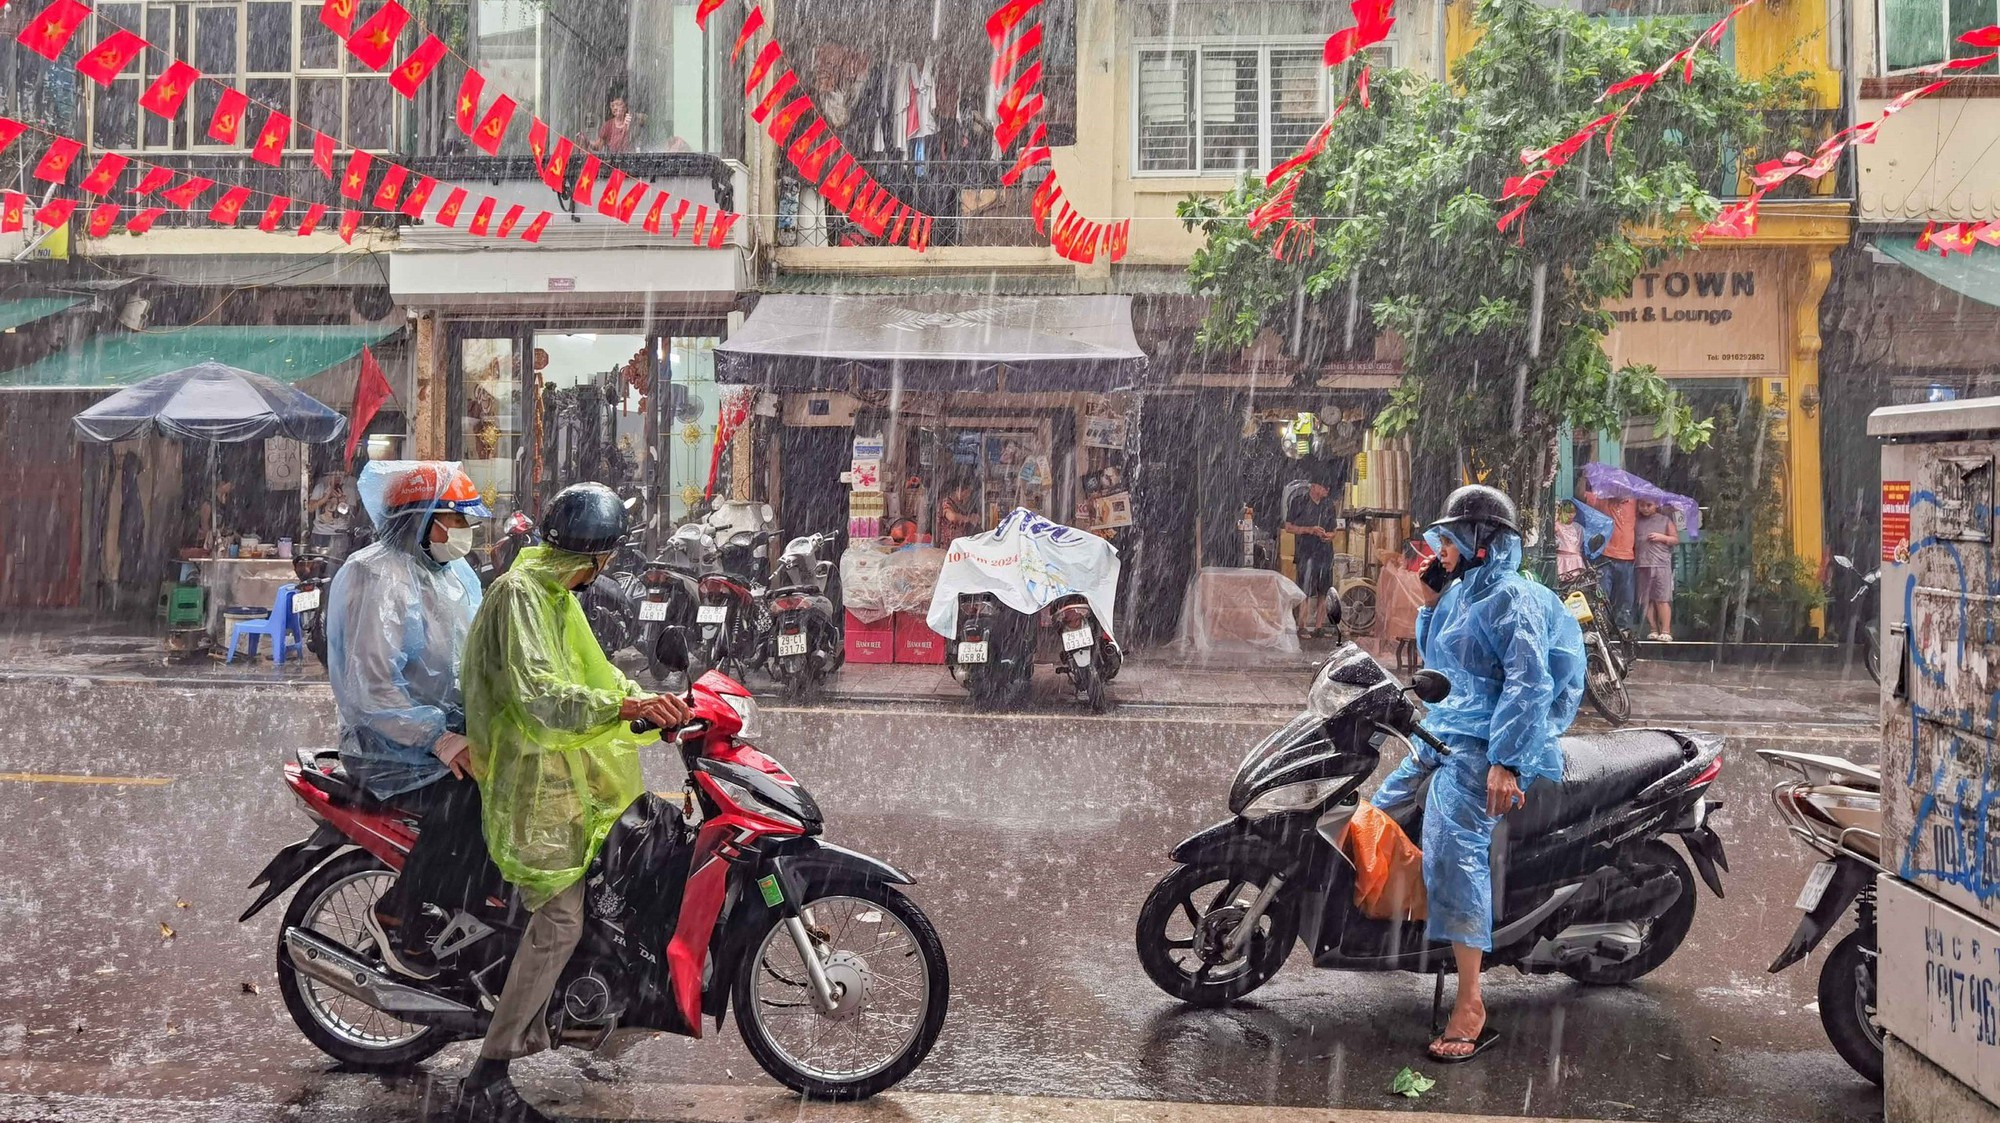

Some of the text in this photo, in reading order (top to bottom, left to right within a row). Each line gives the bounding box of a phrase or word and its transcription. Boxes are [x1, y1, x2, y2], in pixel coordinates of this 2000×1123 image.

[1642, 306, 1656, 322] &
[1661, 307, 1732, 325] Lounge
[948, 552, 960, 563] 10
[991, 554, 1019, 567] 2024
[1592, 810, 1668, 849] VISION
